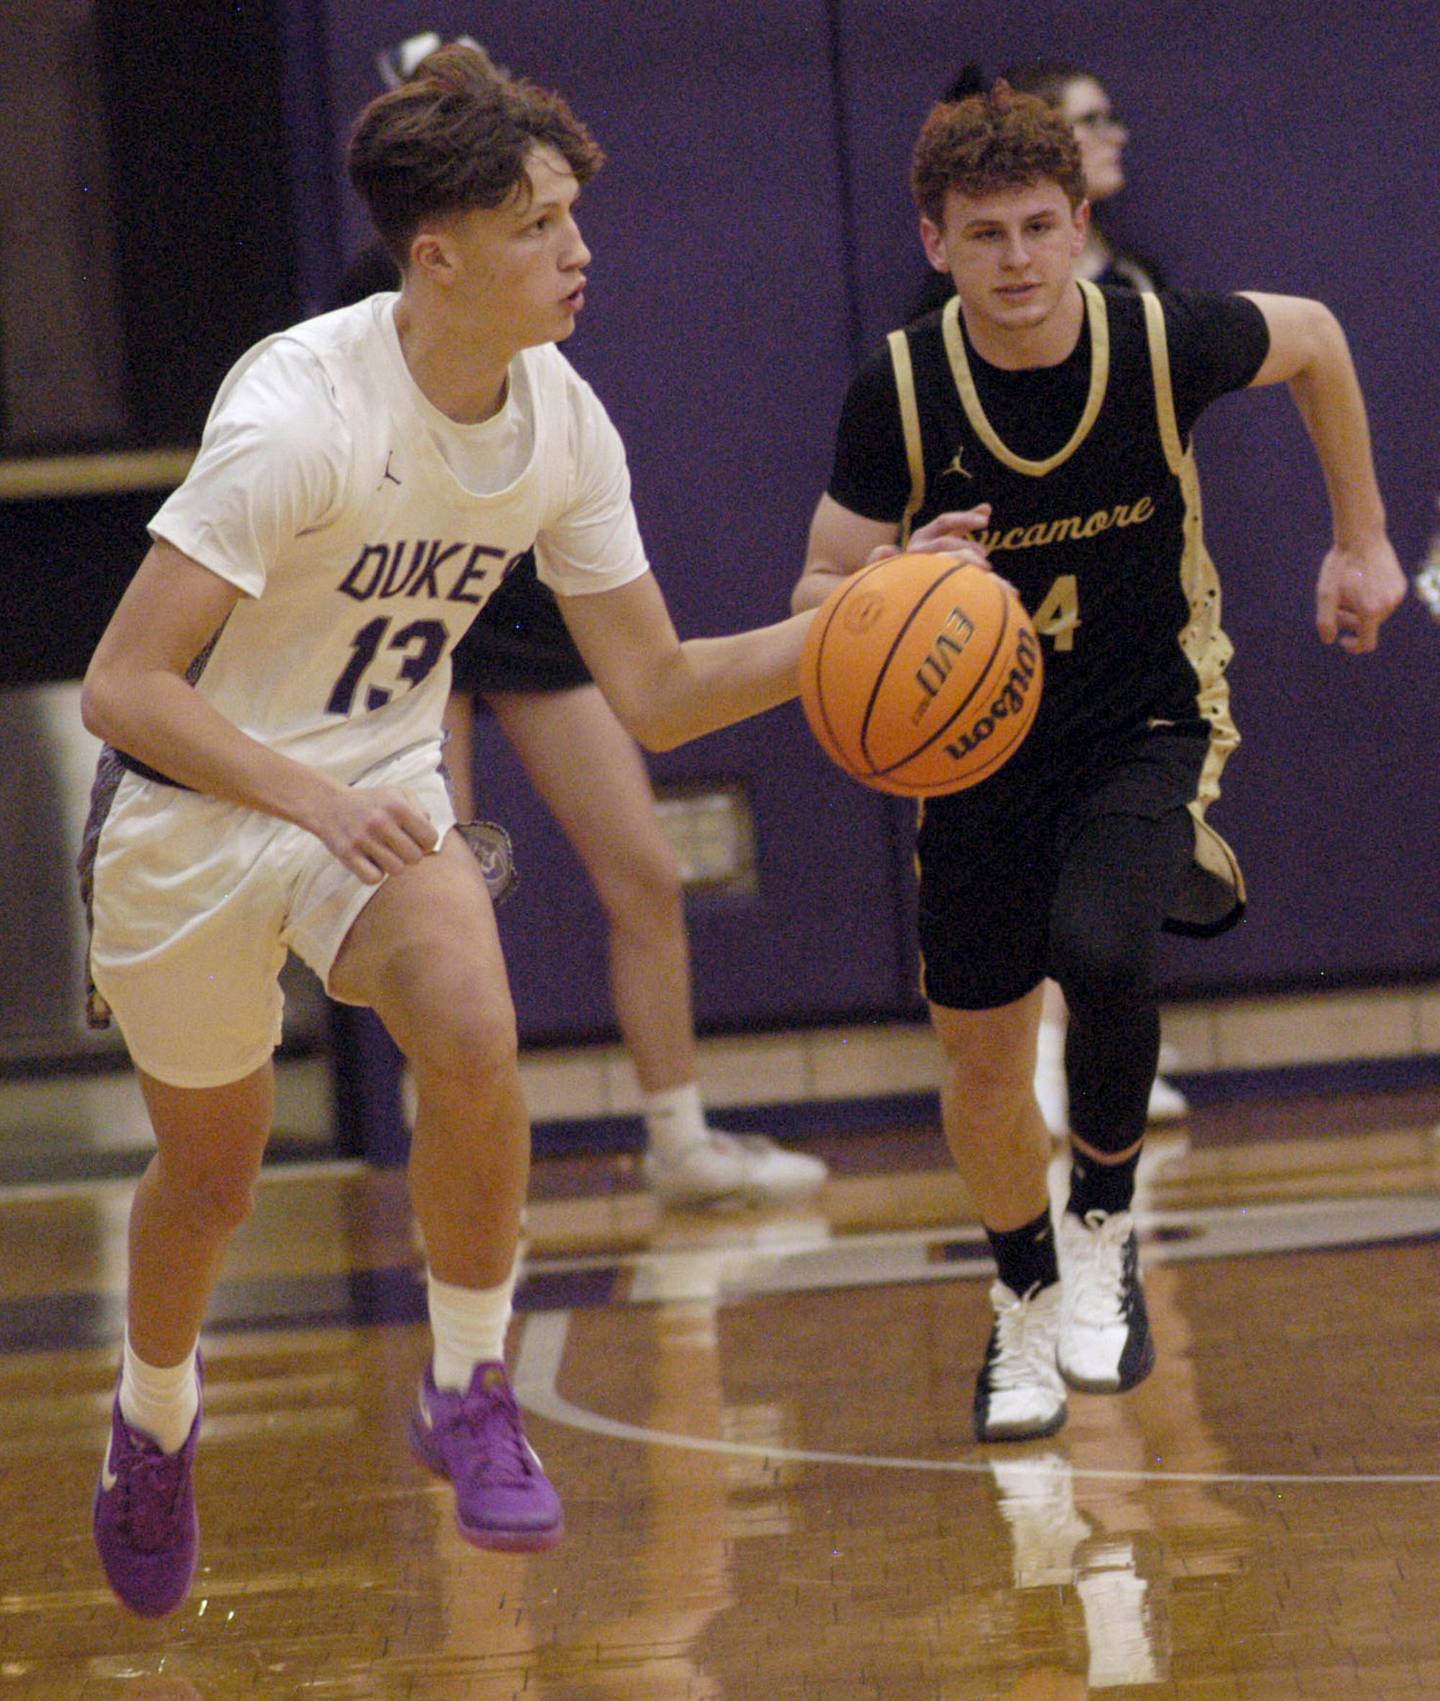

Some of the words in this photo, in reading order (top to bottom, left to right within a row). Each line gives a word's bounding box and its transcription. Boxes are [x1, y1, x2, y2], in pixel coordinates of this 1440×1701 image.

[966, 496, 1155, 557] ycamore
[1031, 574, 1082, 652] 4
[324, 615, 449, 715] 13
